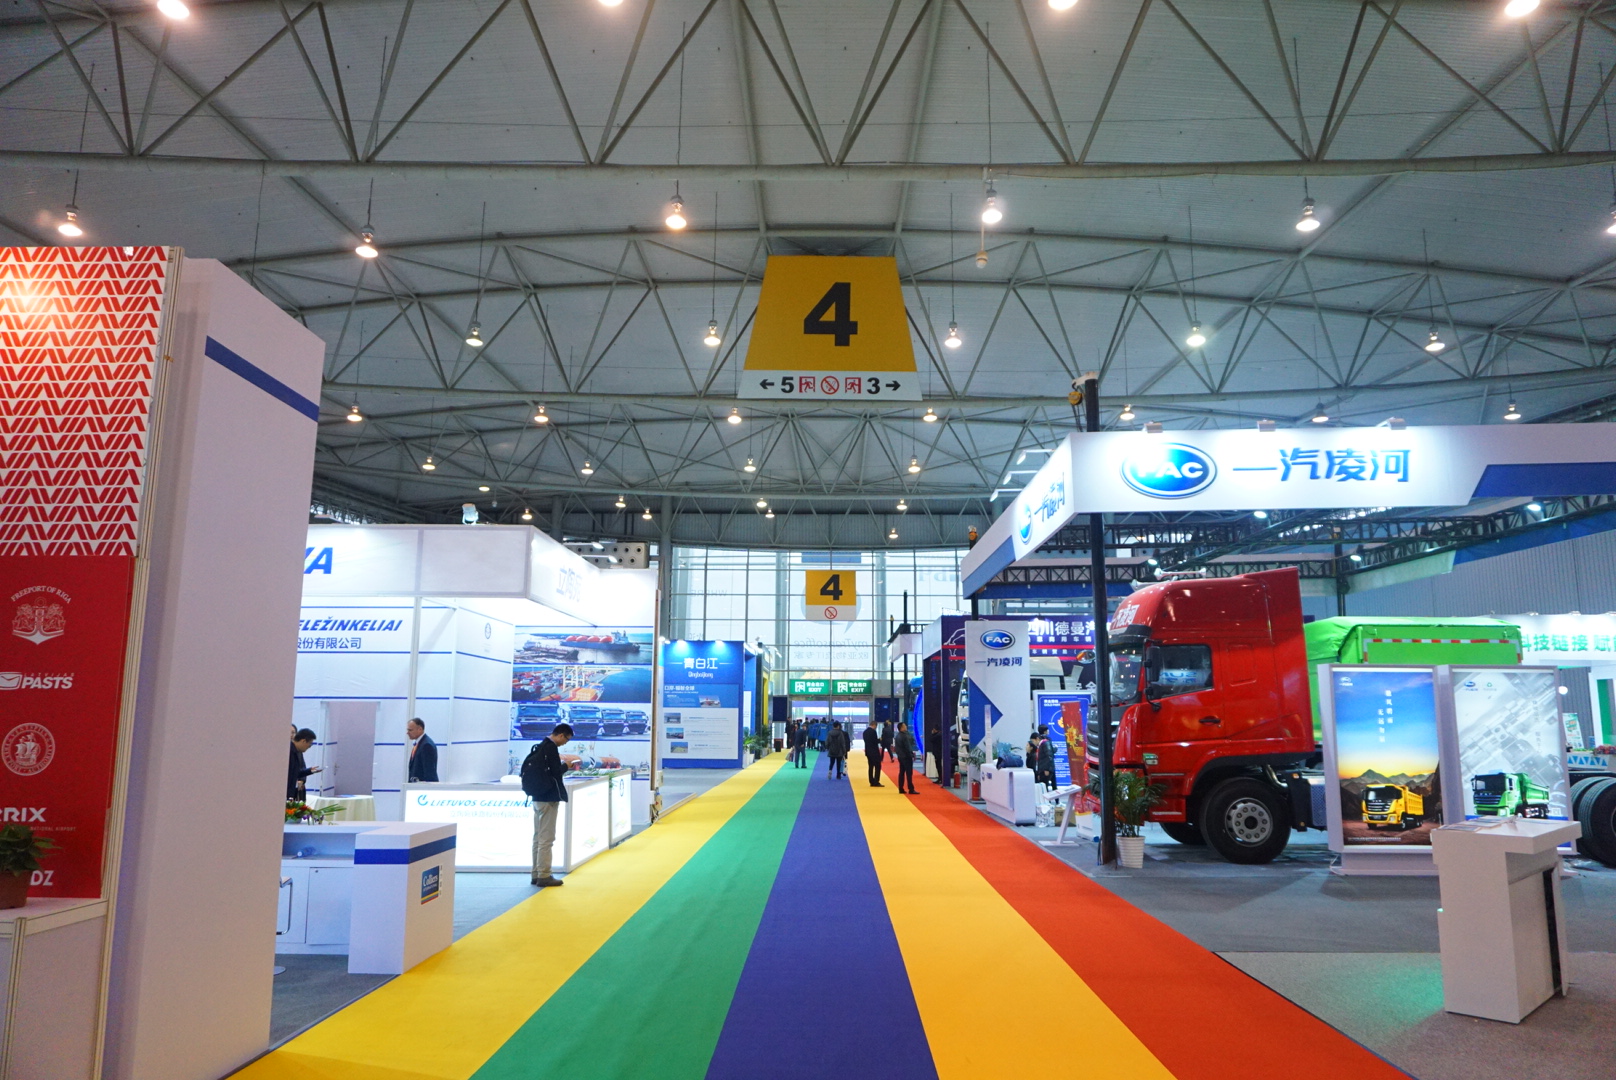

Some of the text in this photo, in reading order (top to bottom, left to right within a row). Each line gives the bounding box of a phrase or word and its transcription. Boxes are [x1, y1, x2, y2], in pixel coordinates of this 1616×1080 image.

[804, 282, 858, 346] 4
[781, 376, 880, 394] 5 3
[1233, 447, 1411, 483] 一汽凌河
[11, 586, 72, 604] FREEPORT OF RIGA
[820, 574, 843, 600] 4
[985, 636, 1010, 644] FAC
[683, 657, 719, 669] 青白江
[974, 657, 1023, 667] 一汽凌河
[21, 677, 73, 689] PASTS
